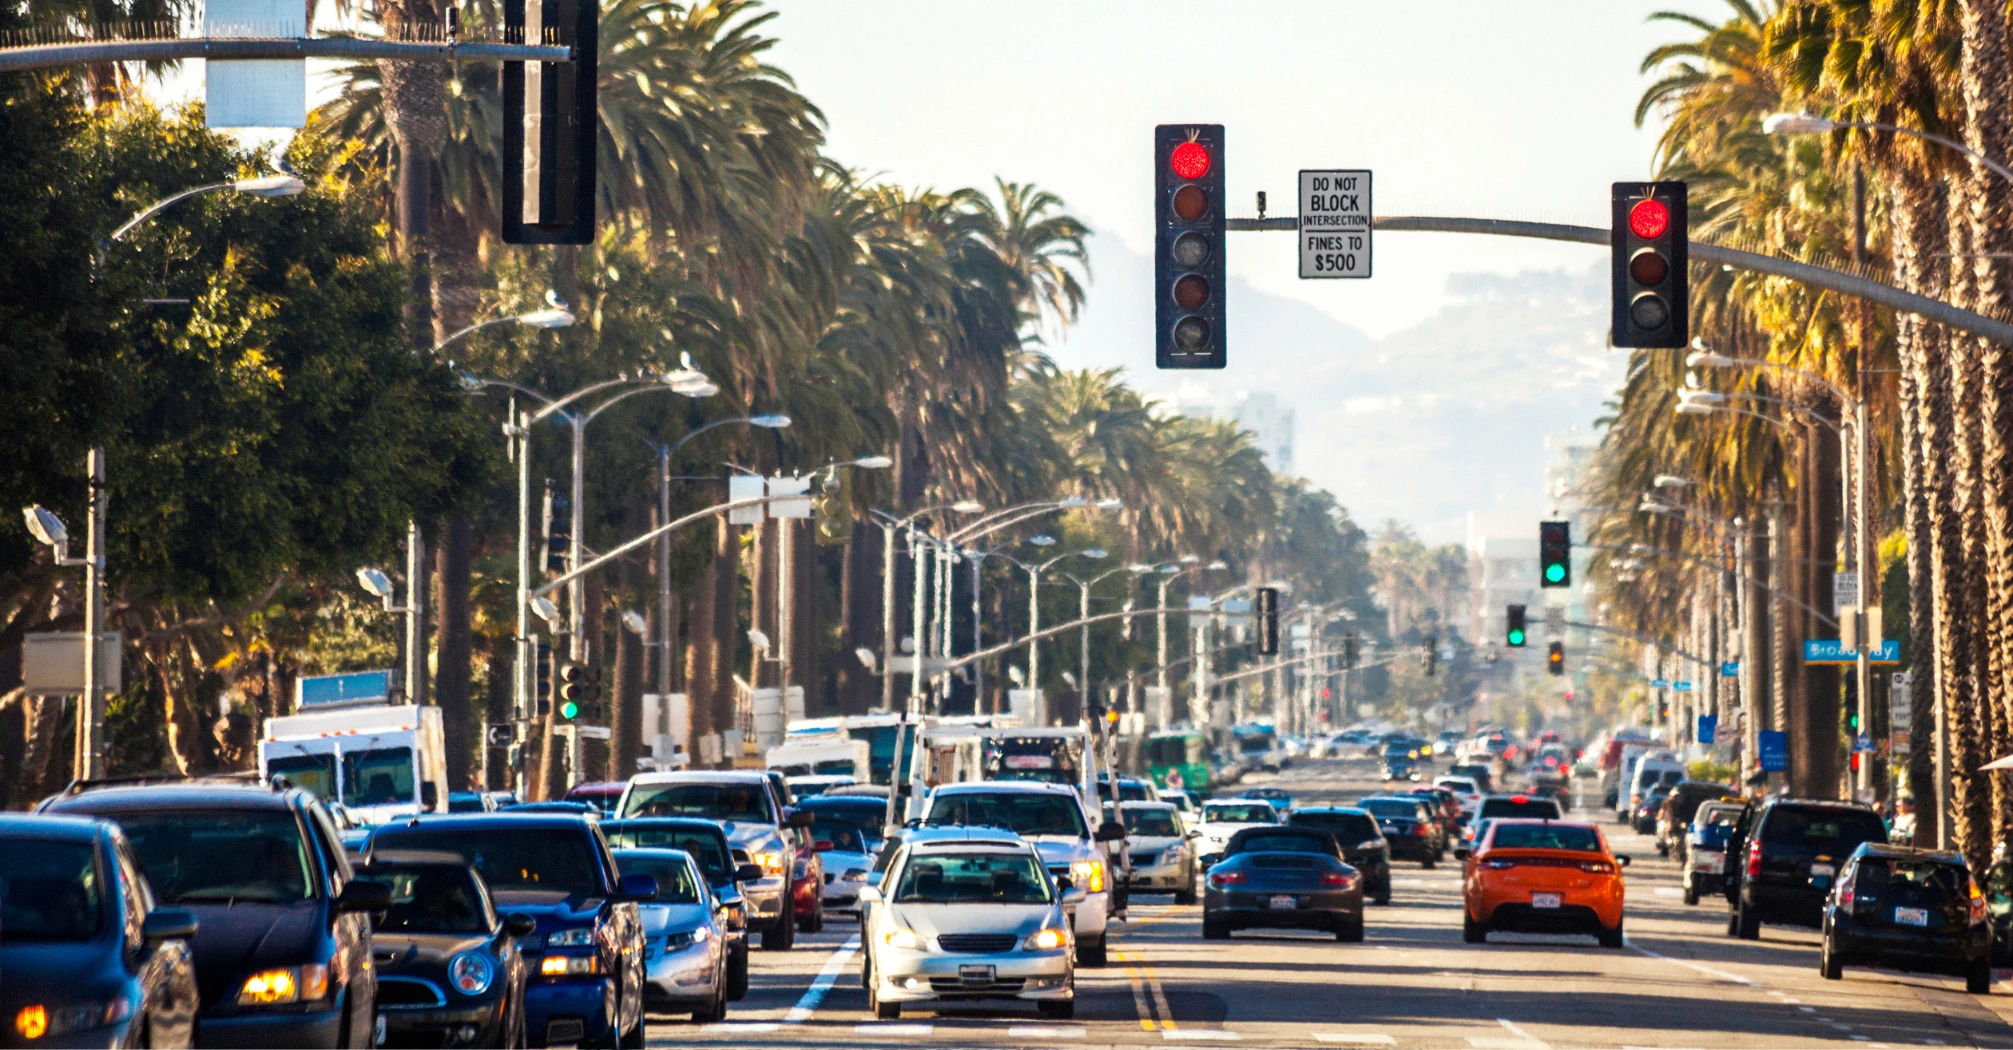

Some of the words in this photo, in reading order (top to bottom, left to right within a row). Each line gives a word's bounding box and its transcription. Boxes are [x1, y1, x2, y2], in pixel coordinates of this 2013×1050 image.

[1313, 177, 1329, 192] DO
[1334, 177, 1357, 192] NOT
[1311, 194, 1359, 212] BLOCK
[1303, 215, 1368, 226] INTERSECTION
[1308, 236, 1343, 251] FINES
[1348, 236, 1363, 251] TO
[1315, 253, 1356, 272] $500
